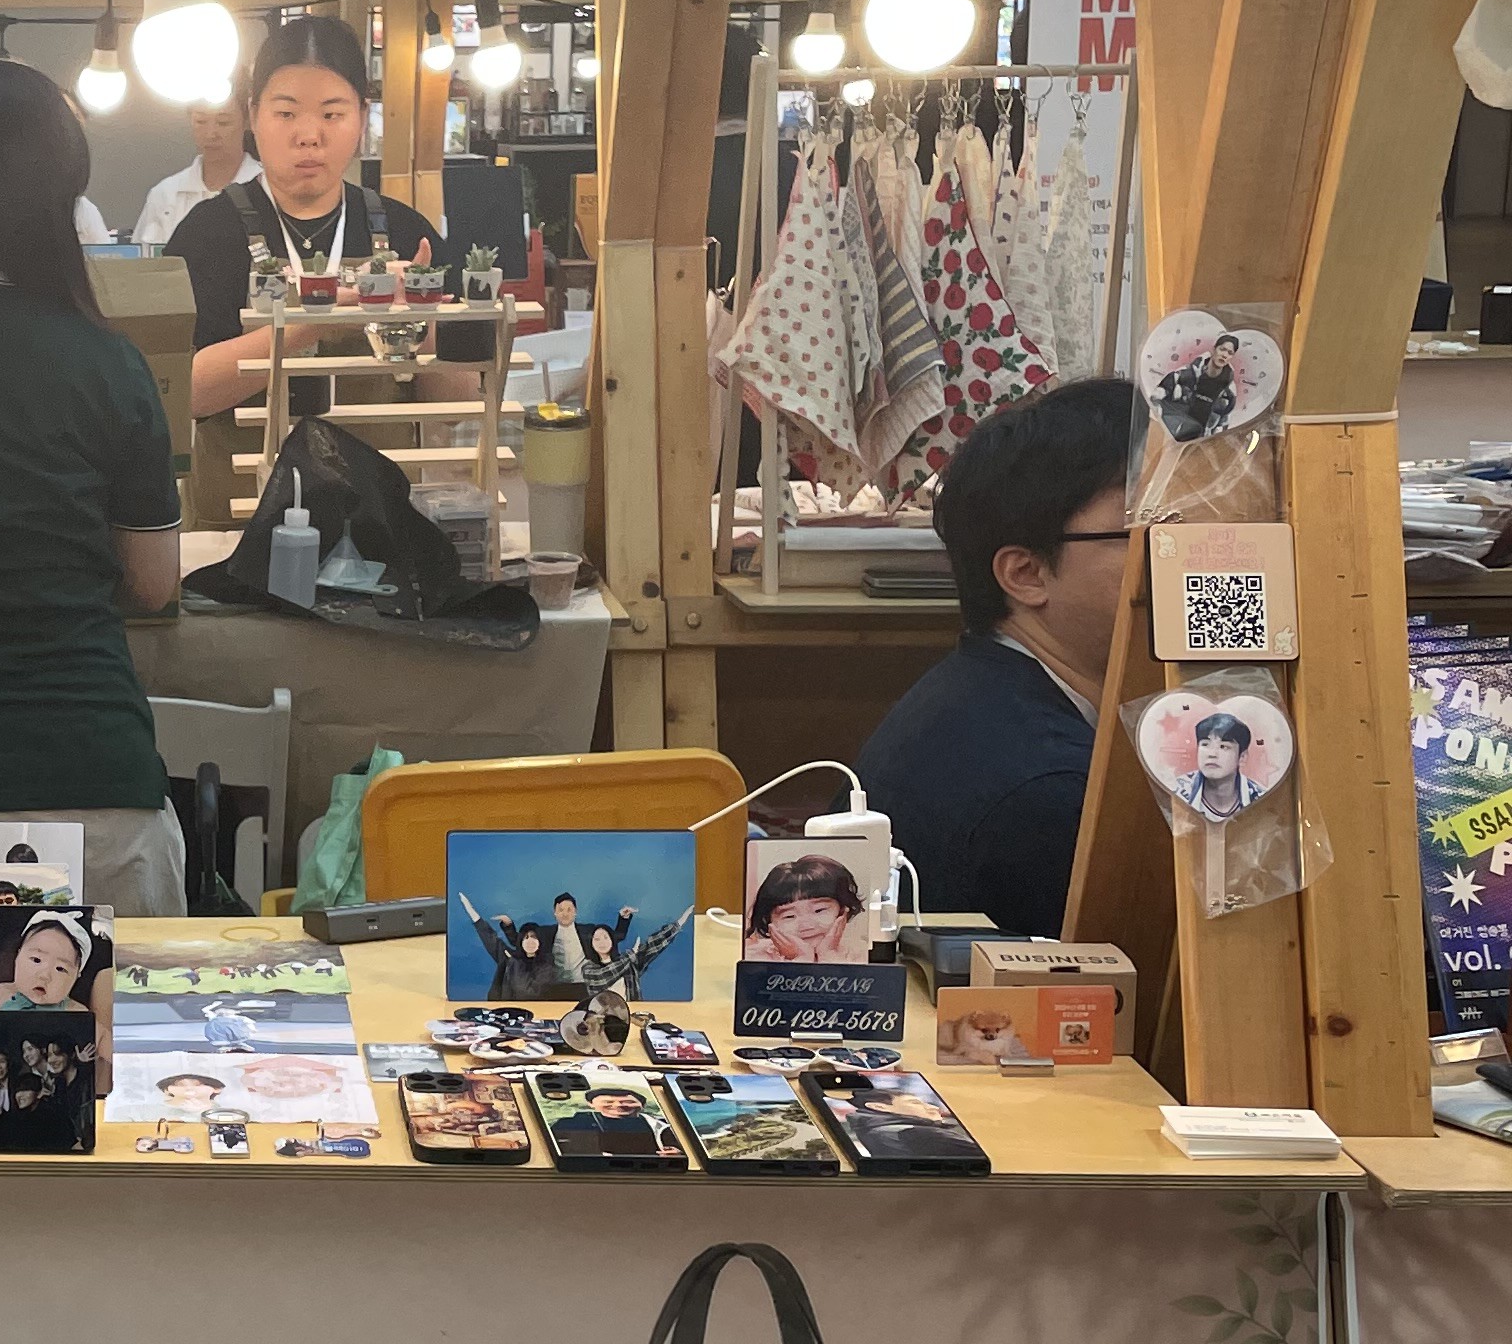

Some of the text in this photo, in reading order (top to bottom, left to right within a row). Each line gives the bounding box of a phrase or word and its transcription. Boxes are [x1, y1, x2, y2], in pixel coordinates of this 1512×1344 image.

[999, 953, 1119, 965] BUSINESS
[1444, 944, 1502, 972] vol.
[766, 974, 875, 994] PARKING
[742, 1006, 899, 1032] 010-1234-5678
